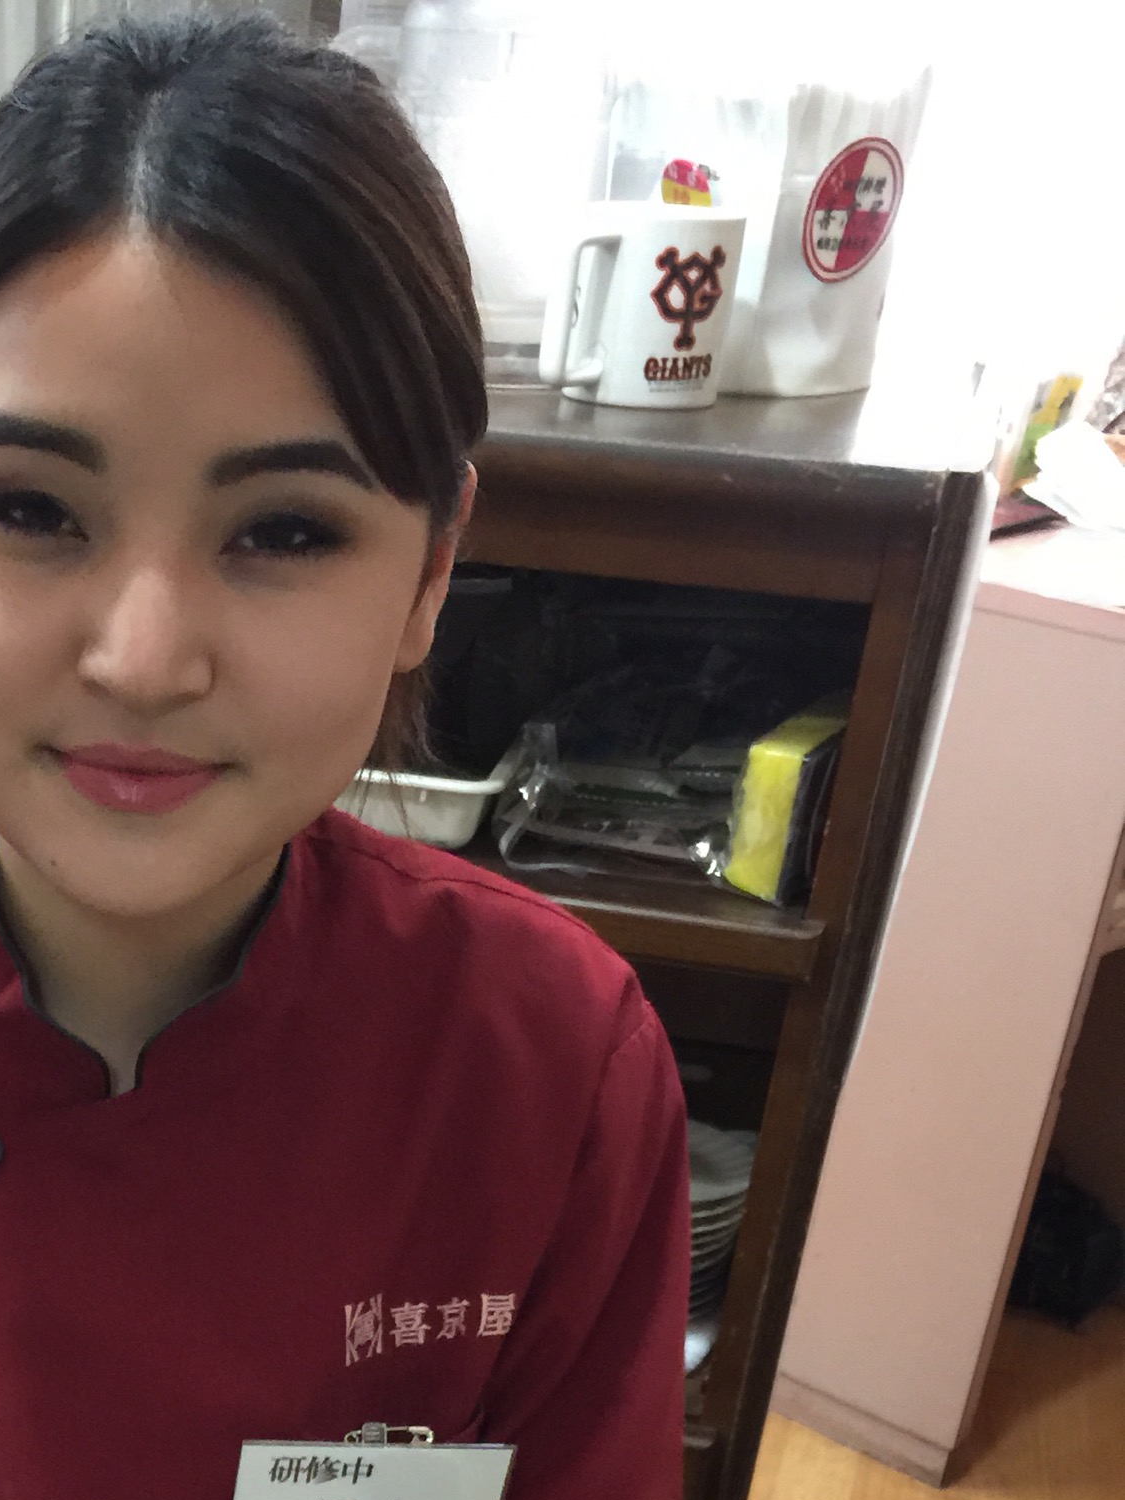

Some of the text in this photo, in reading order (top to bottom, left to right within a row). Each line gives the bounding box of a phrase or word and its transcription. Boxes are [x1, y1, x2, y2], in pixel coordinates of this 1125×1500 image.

[643, 353, 713, 382] GIANTS
[389, 1292, 516, 1348] 喜京屋
[269, 1456, 374, 1484] 研修中
